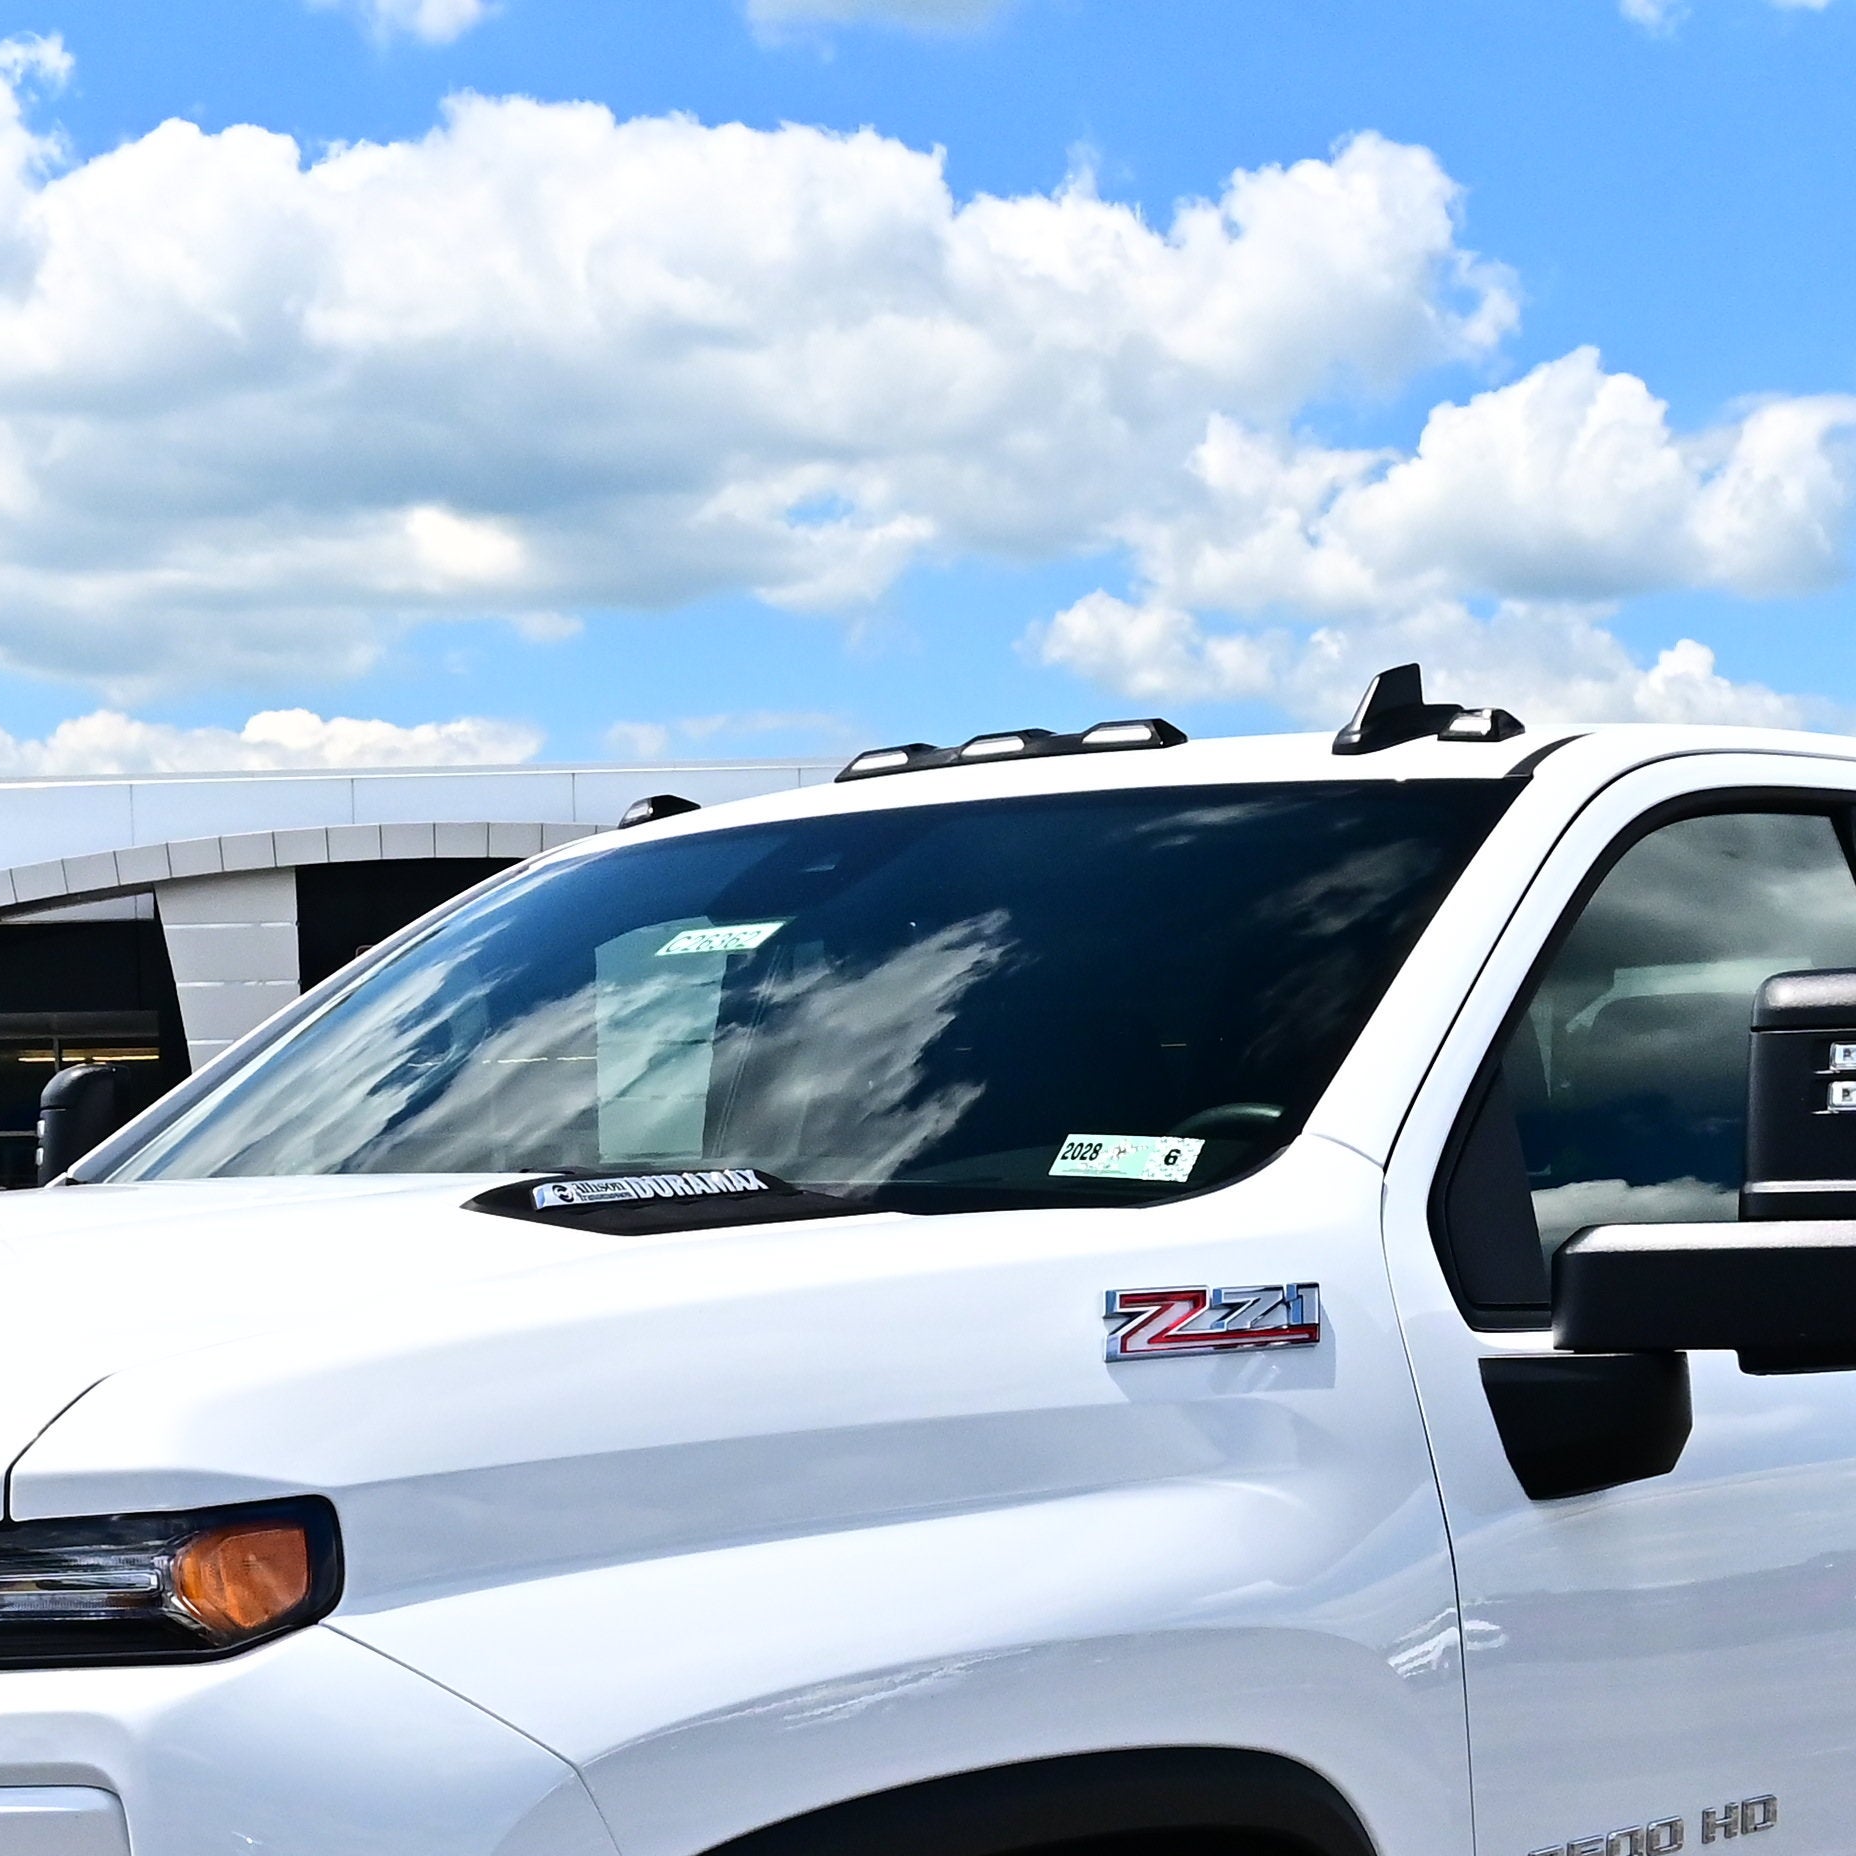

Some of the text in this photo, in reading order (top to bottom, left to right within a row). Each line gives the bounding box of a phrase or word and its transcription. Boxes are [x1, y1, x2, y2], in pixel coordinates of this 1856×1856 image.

[1060, 1142, 1182, 1167] 2028 6
[627, 1168, 770, 1199] DURAMAX
[1103, 1282, 1321, 1363] Z71
[1701, 1793, 1778, 1845] HD
